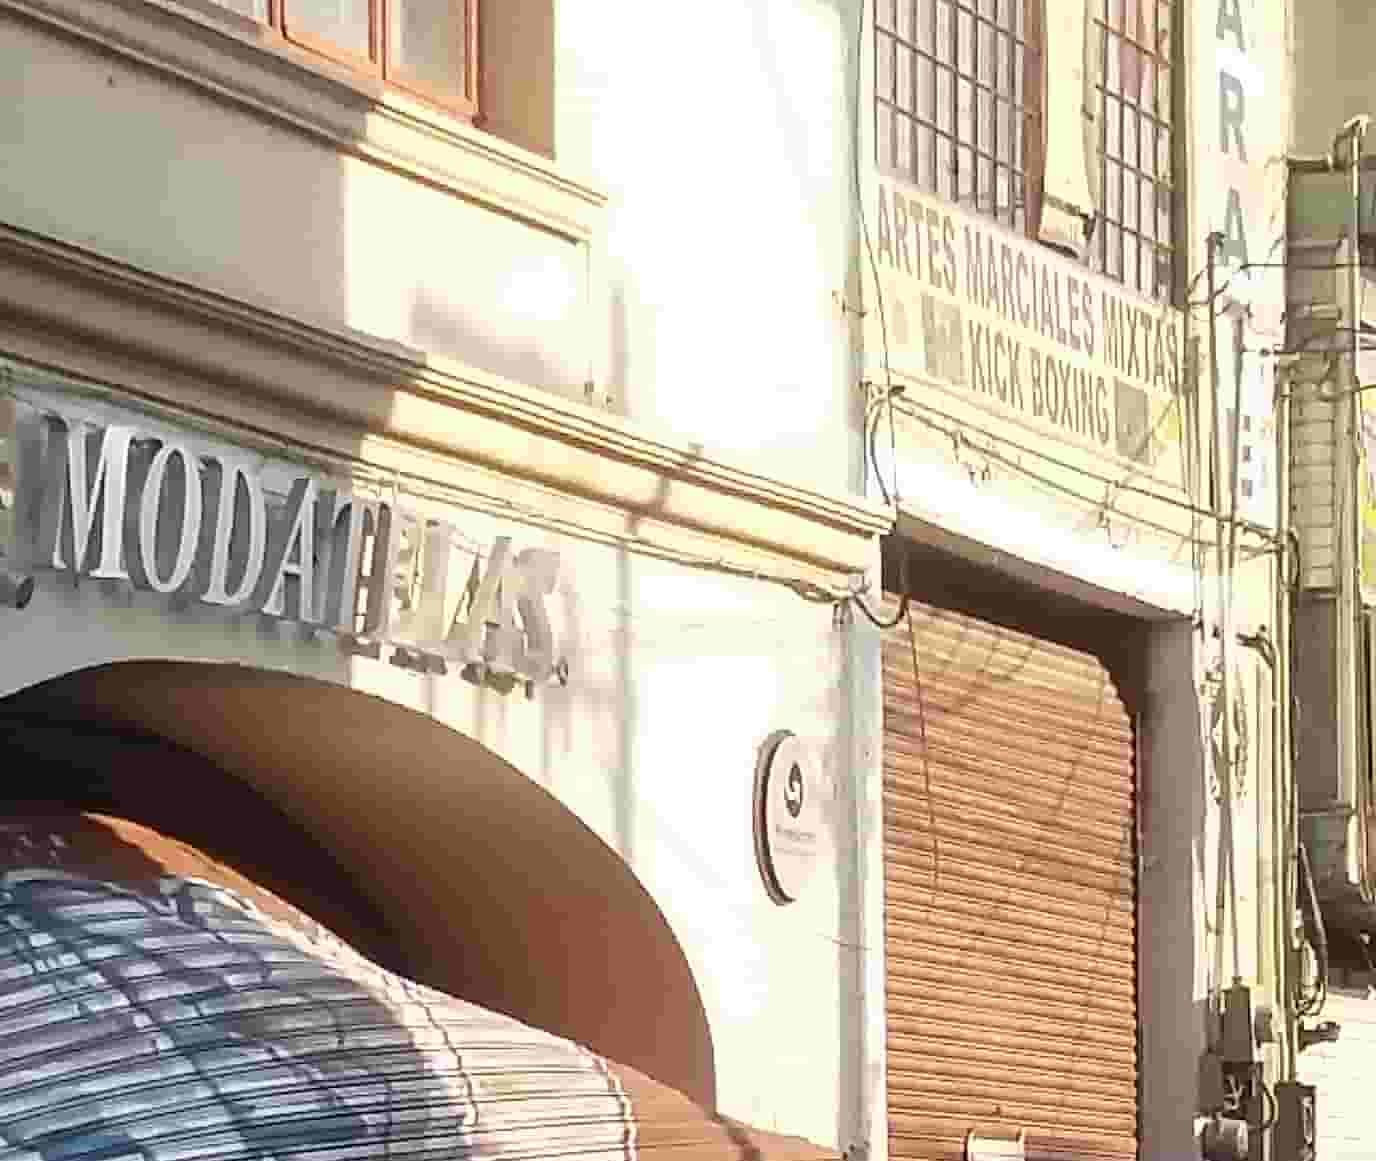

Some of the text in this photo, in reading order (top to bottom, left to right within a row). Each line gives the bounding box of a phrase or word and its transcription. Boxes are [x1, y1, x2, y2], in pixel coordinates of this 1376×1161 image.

[878, 184, 1179, 396] ARTES MARCIALES MIXTAS
[969, 319, 1111, 447] KICK BOXING
[49, 420, 562, 684] MODATELAS
